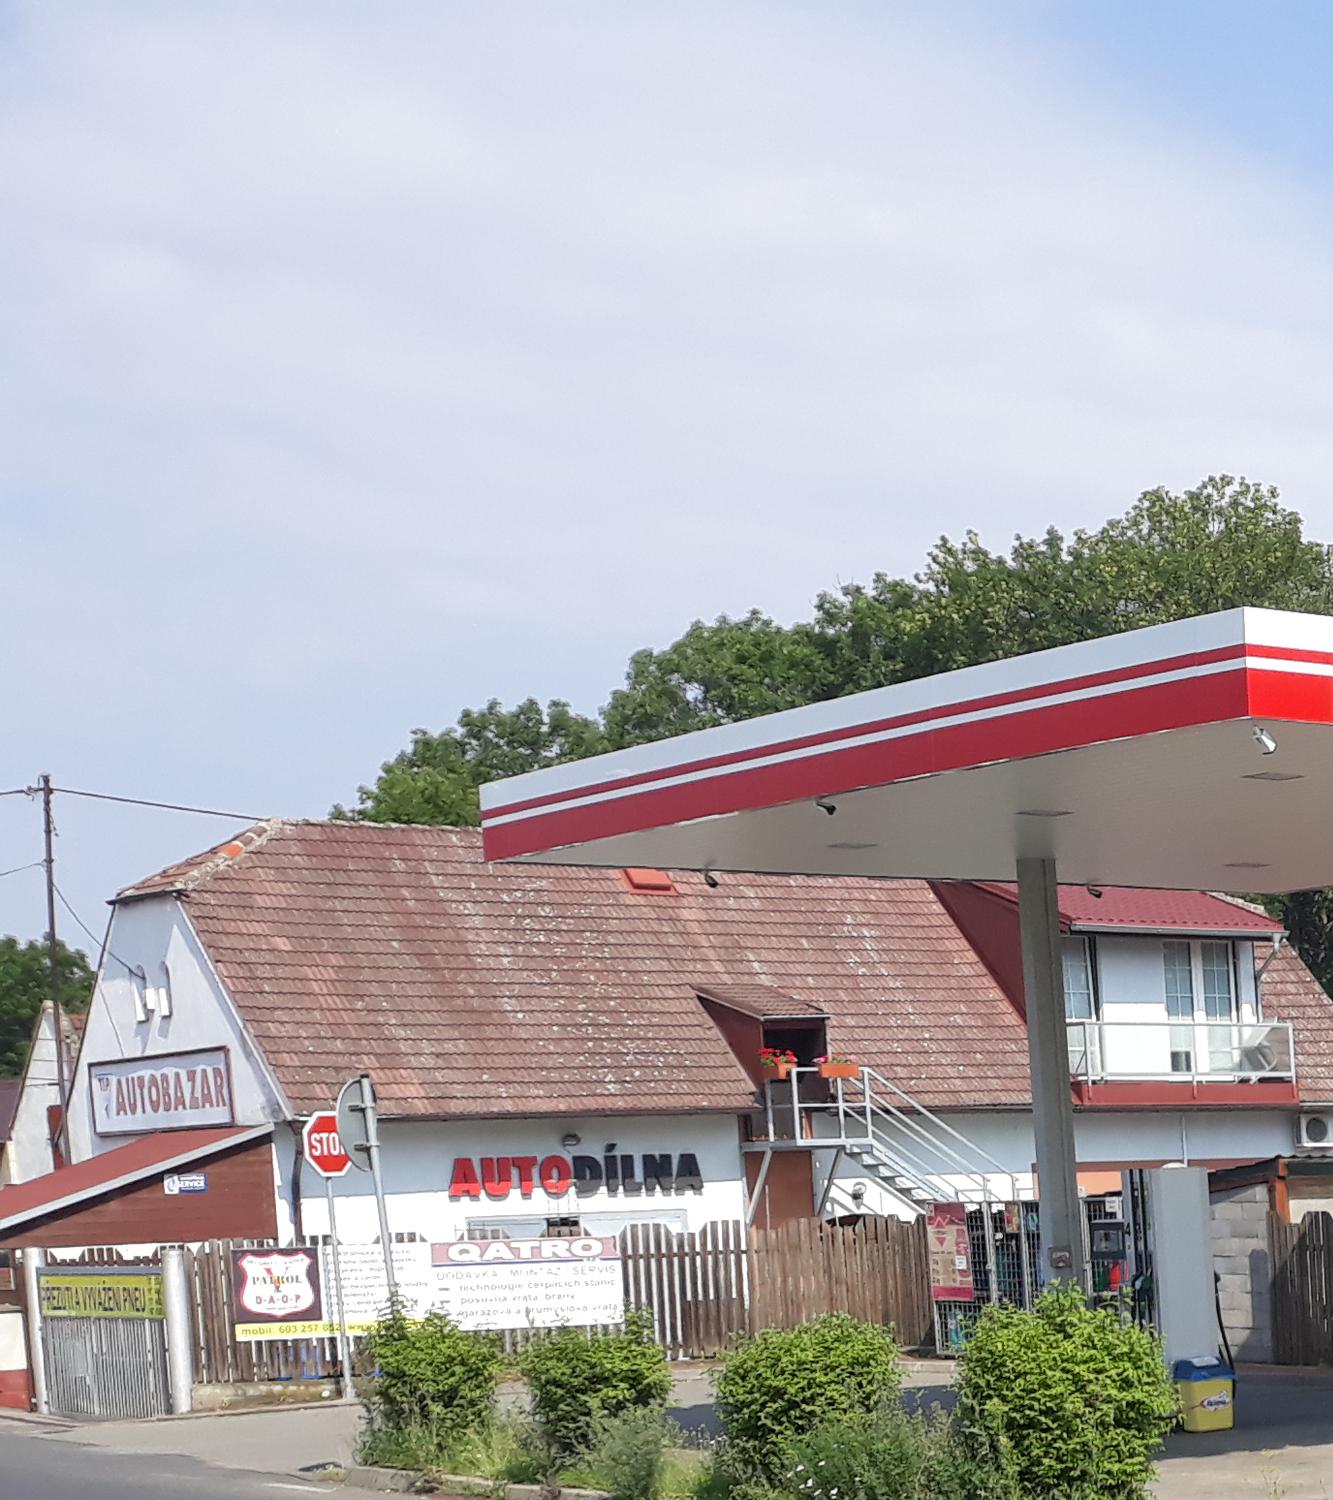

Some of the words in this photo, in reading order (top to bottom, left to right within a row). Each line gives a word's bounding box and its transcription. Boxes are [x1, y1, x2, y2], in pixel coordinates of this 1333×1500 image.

[116, 1066, 227, 1116] AUTOBAZAR
[310, 1131, 346, 1157] STO
[447, 1237, 603, 1263] QATRO
[278, 1325, 298, 1335] 603
[300, 1324, 319, 1334] 257
